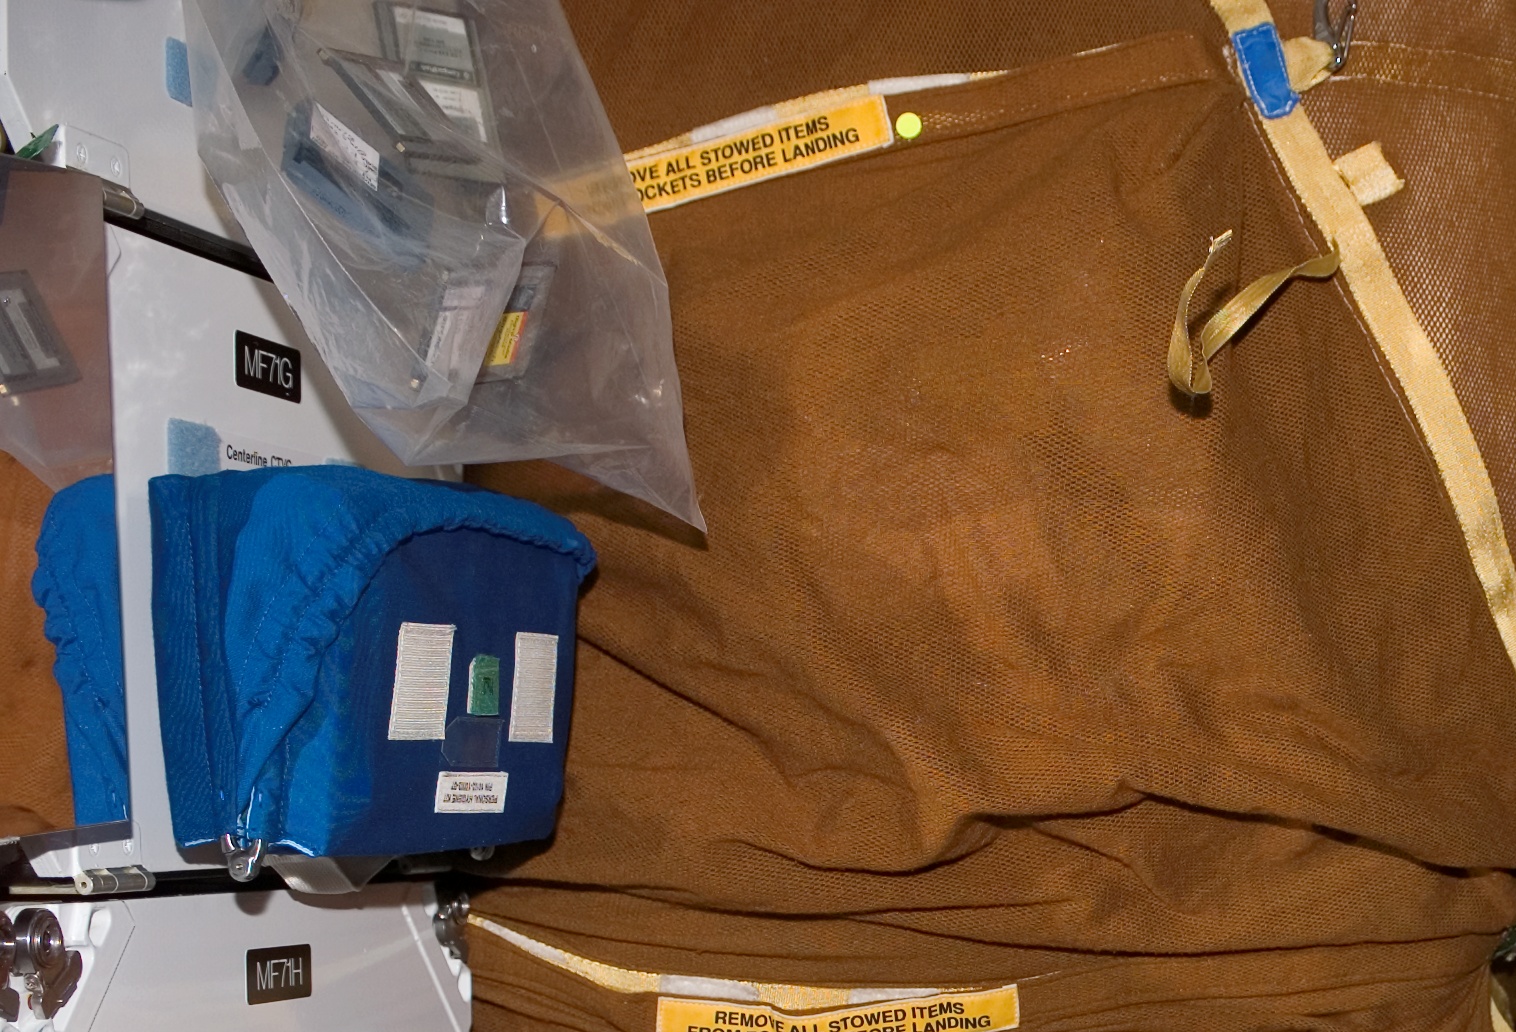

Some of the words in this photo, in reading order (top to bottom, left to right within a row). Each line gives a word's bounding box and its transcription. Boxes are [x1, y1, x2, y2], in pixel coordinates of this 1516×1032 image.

[665, 155, 697, 177] ALL
[700, 132, 775, 165] STOWED
[779, 115, 830, 145] ITEMS
[706, 151, 778, 184] BEFORE
[783, 127, 860, 163] LANDING
[244, 344, 294, 390] MF71G
[226, 444, 268, 467] Centerline
[256, 957, 304, 990] MF71H
[911, 1001, 965, 1019] ITEMS
